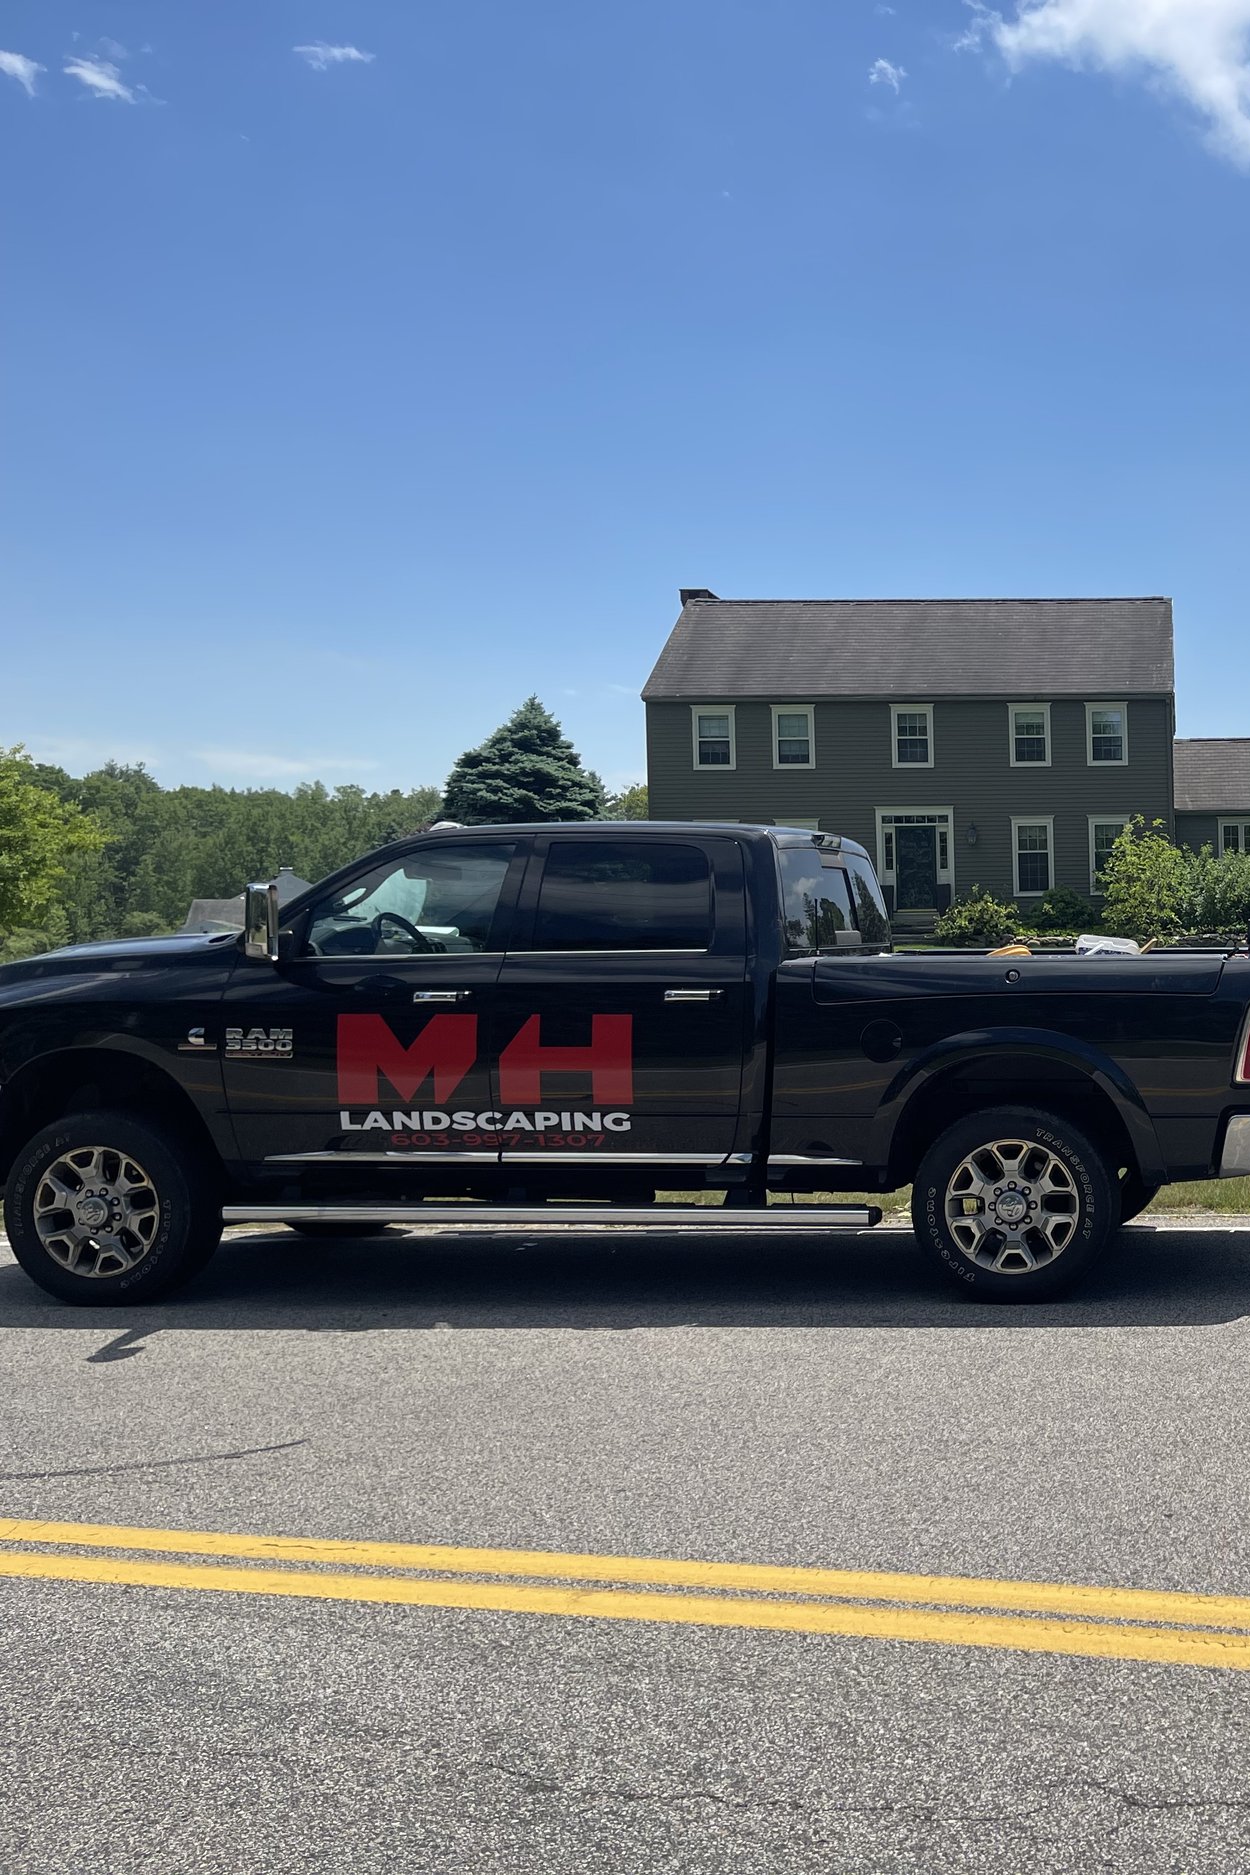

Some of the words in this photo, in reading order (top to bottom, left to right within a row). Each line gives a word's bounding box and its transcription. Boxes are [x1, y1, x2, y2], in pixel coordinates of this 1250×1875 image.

[225, 1028, 293, 1040] RAM
[225, 1039, 293, 1051] 3500
[337, 1014, 633, 1104] MH
[340, 1111, 631, 1131] LANDSCAPING
[391, 1134, 606, 1147] 603-997-1307
[1036, 1127, 1095, 1213] TRANSFORCE
[1082, 1217, 1094, 1239] AT
